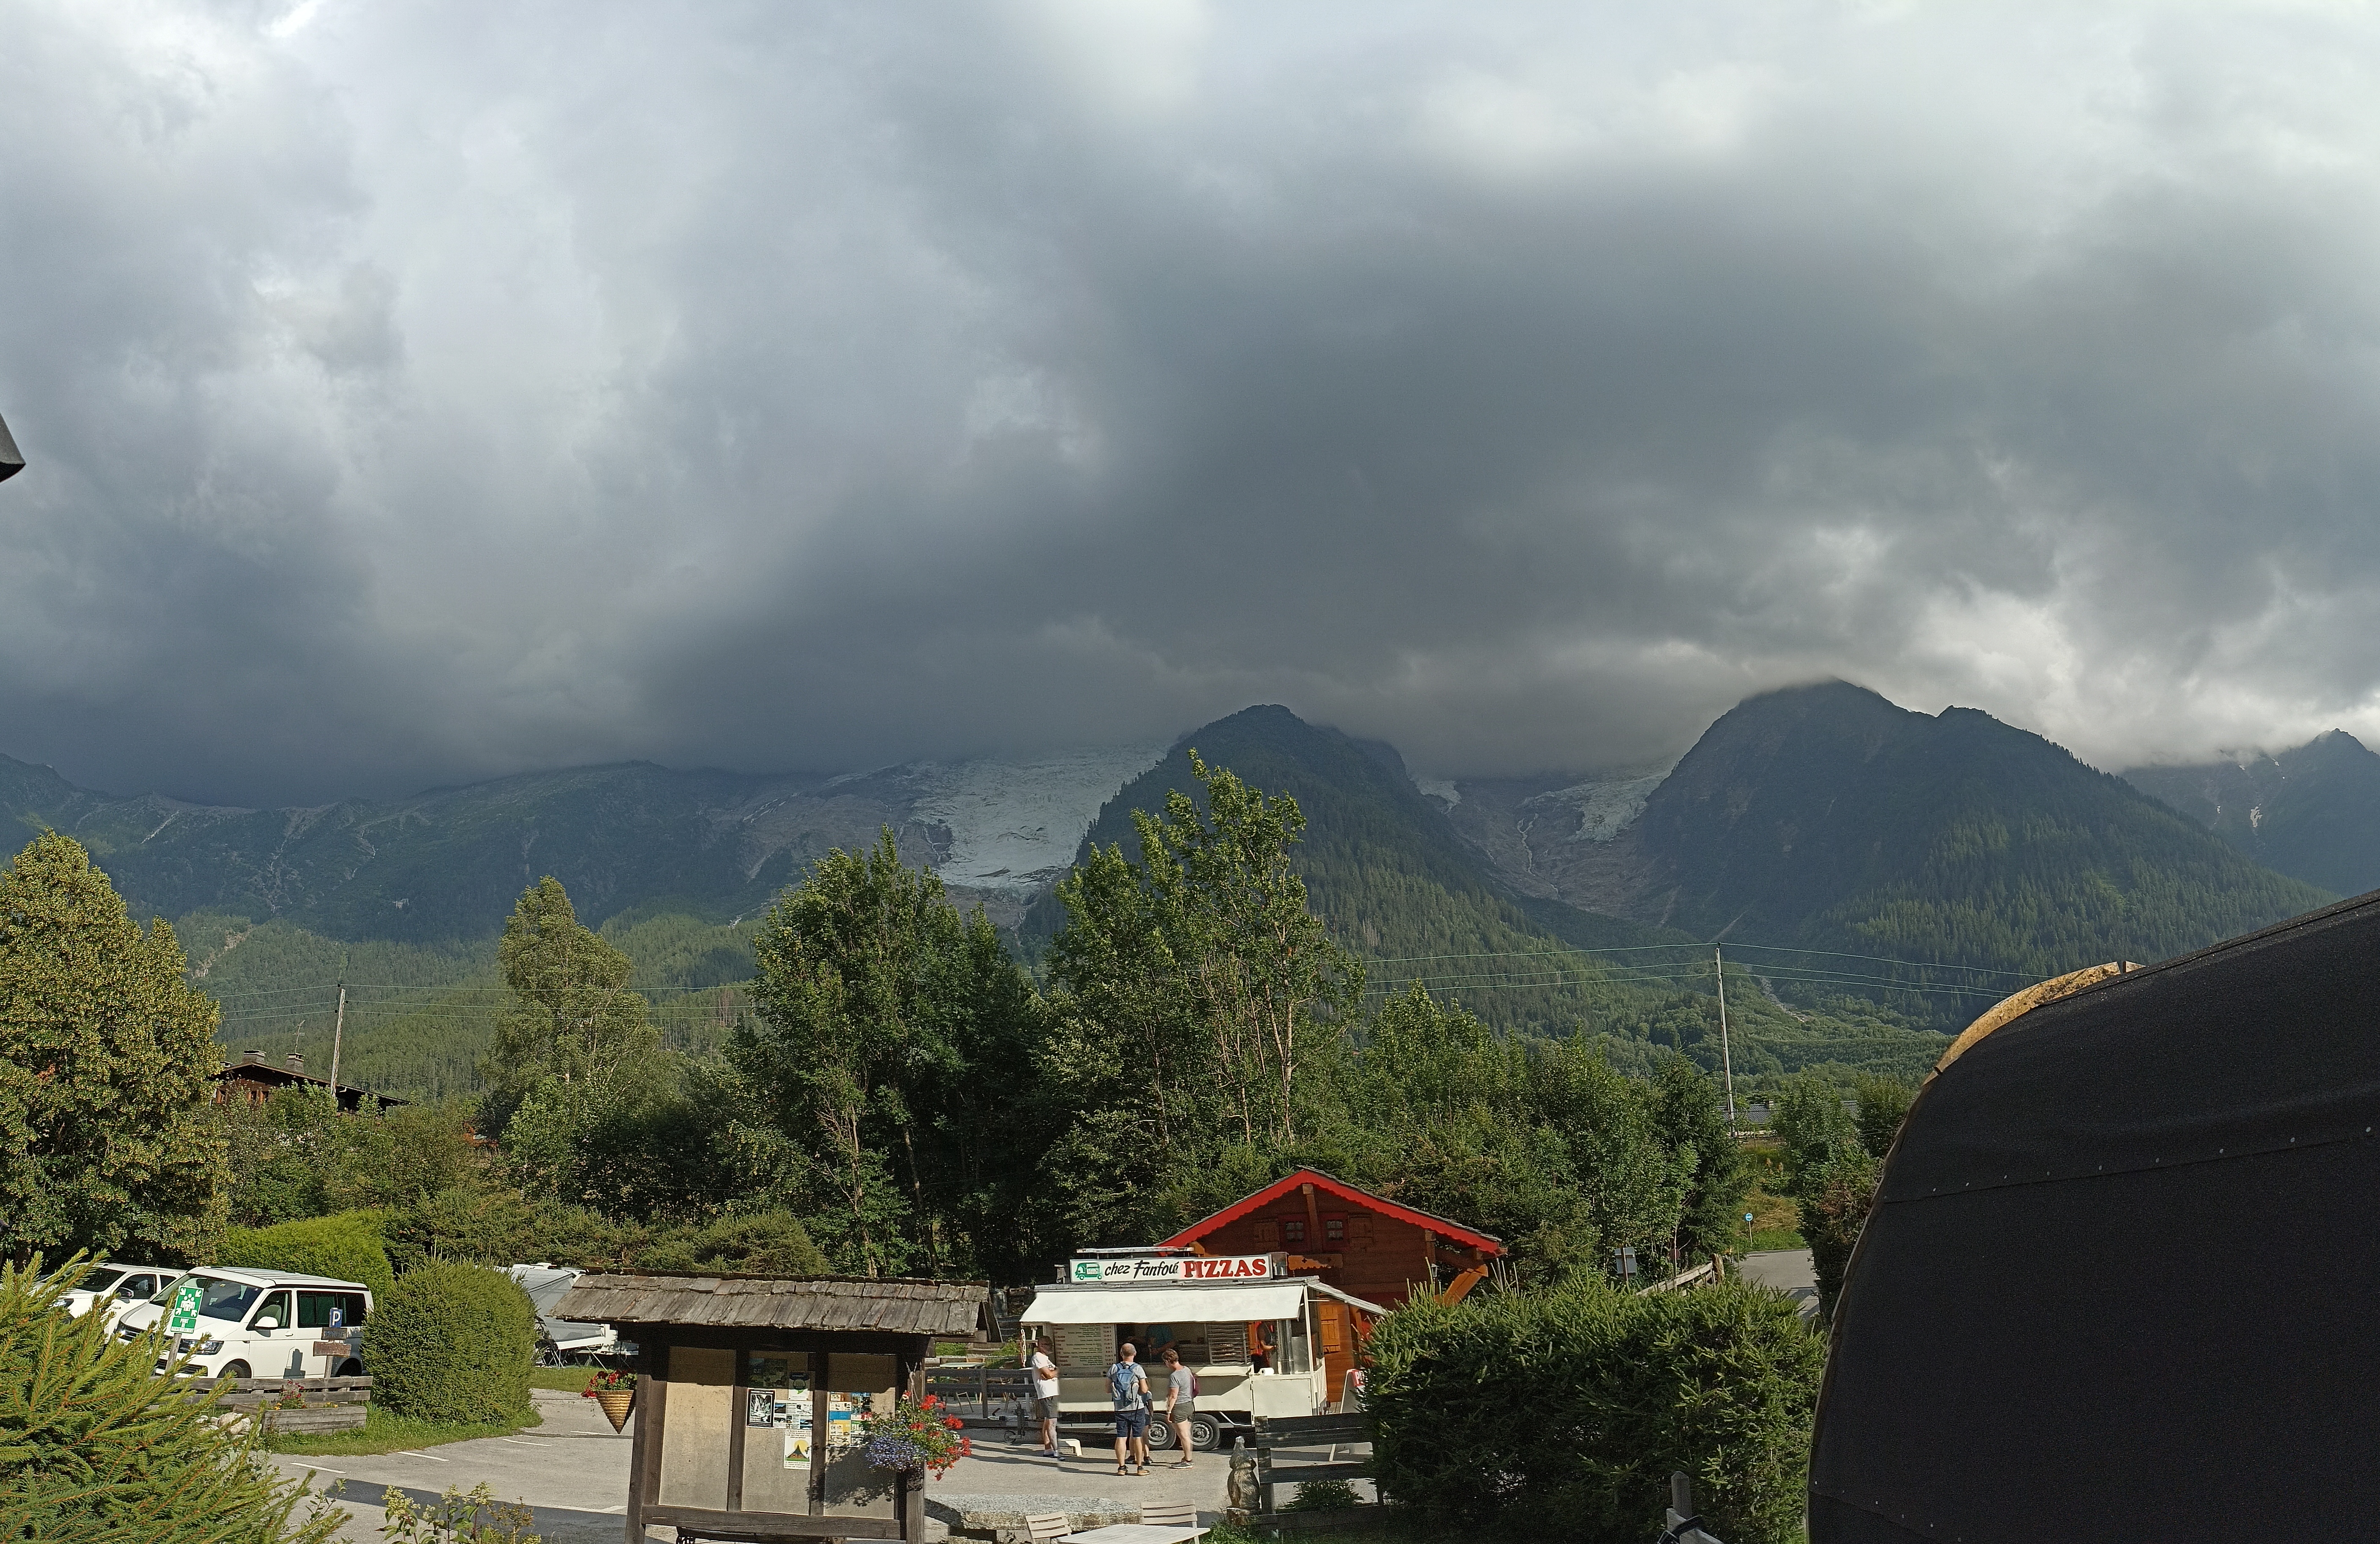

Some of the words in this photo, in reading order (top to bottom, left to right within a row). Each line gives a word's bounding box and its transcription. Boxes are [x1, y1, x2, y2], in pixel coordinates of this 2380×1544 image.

[1105, 1262, 1130, 1276] chez
[1183, 1258, 1267, 1278] PIZZAS
[332, 1311, 341, 1326] P
